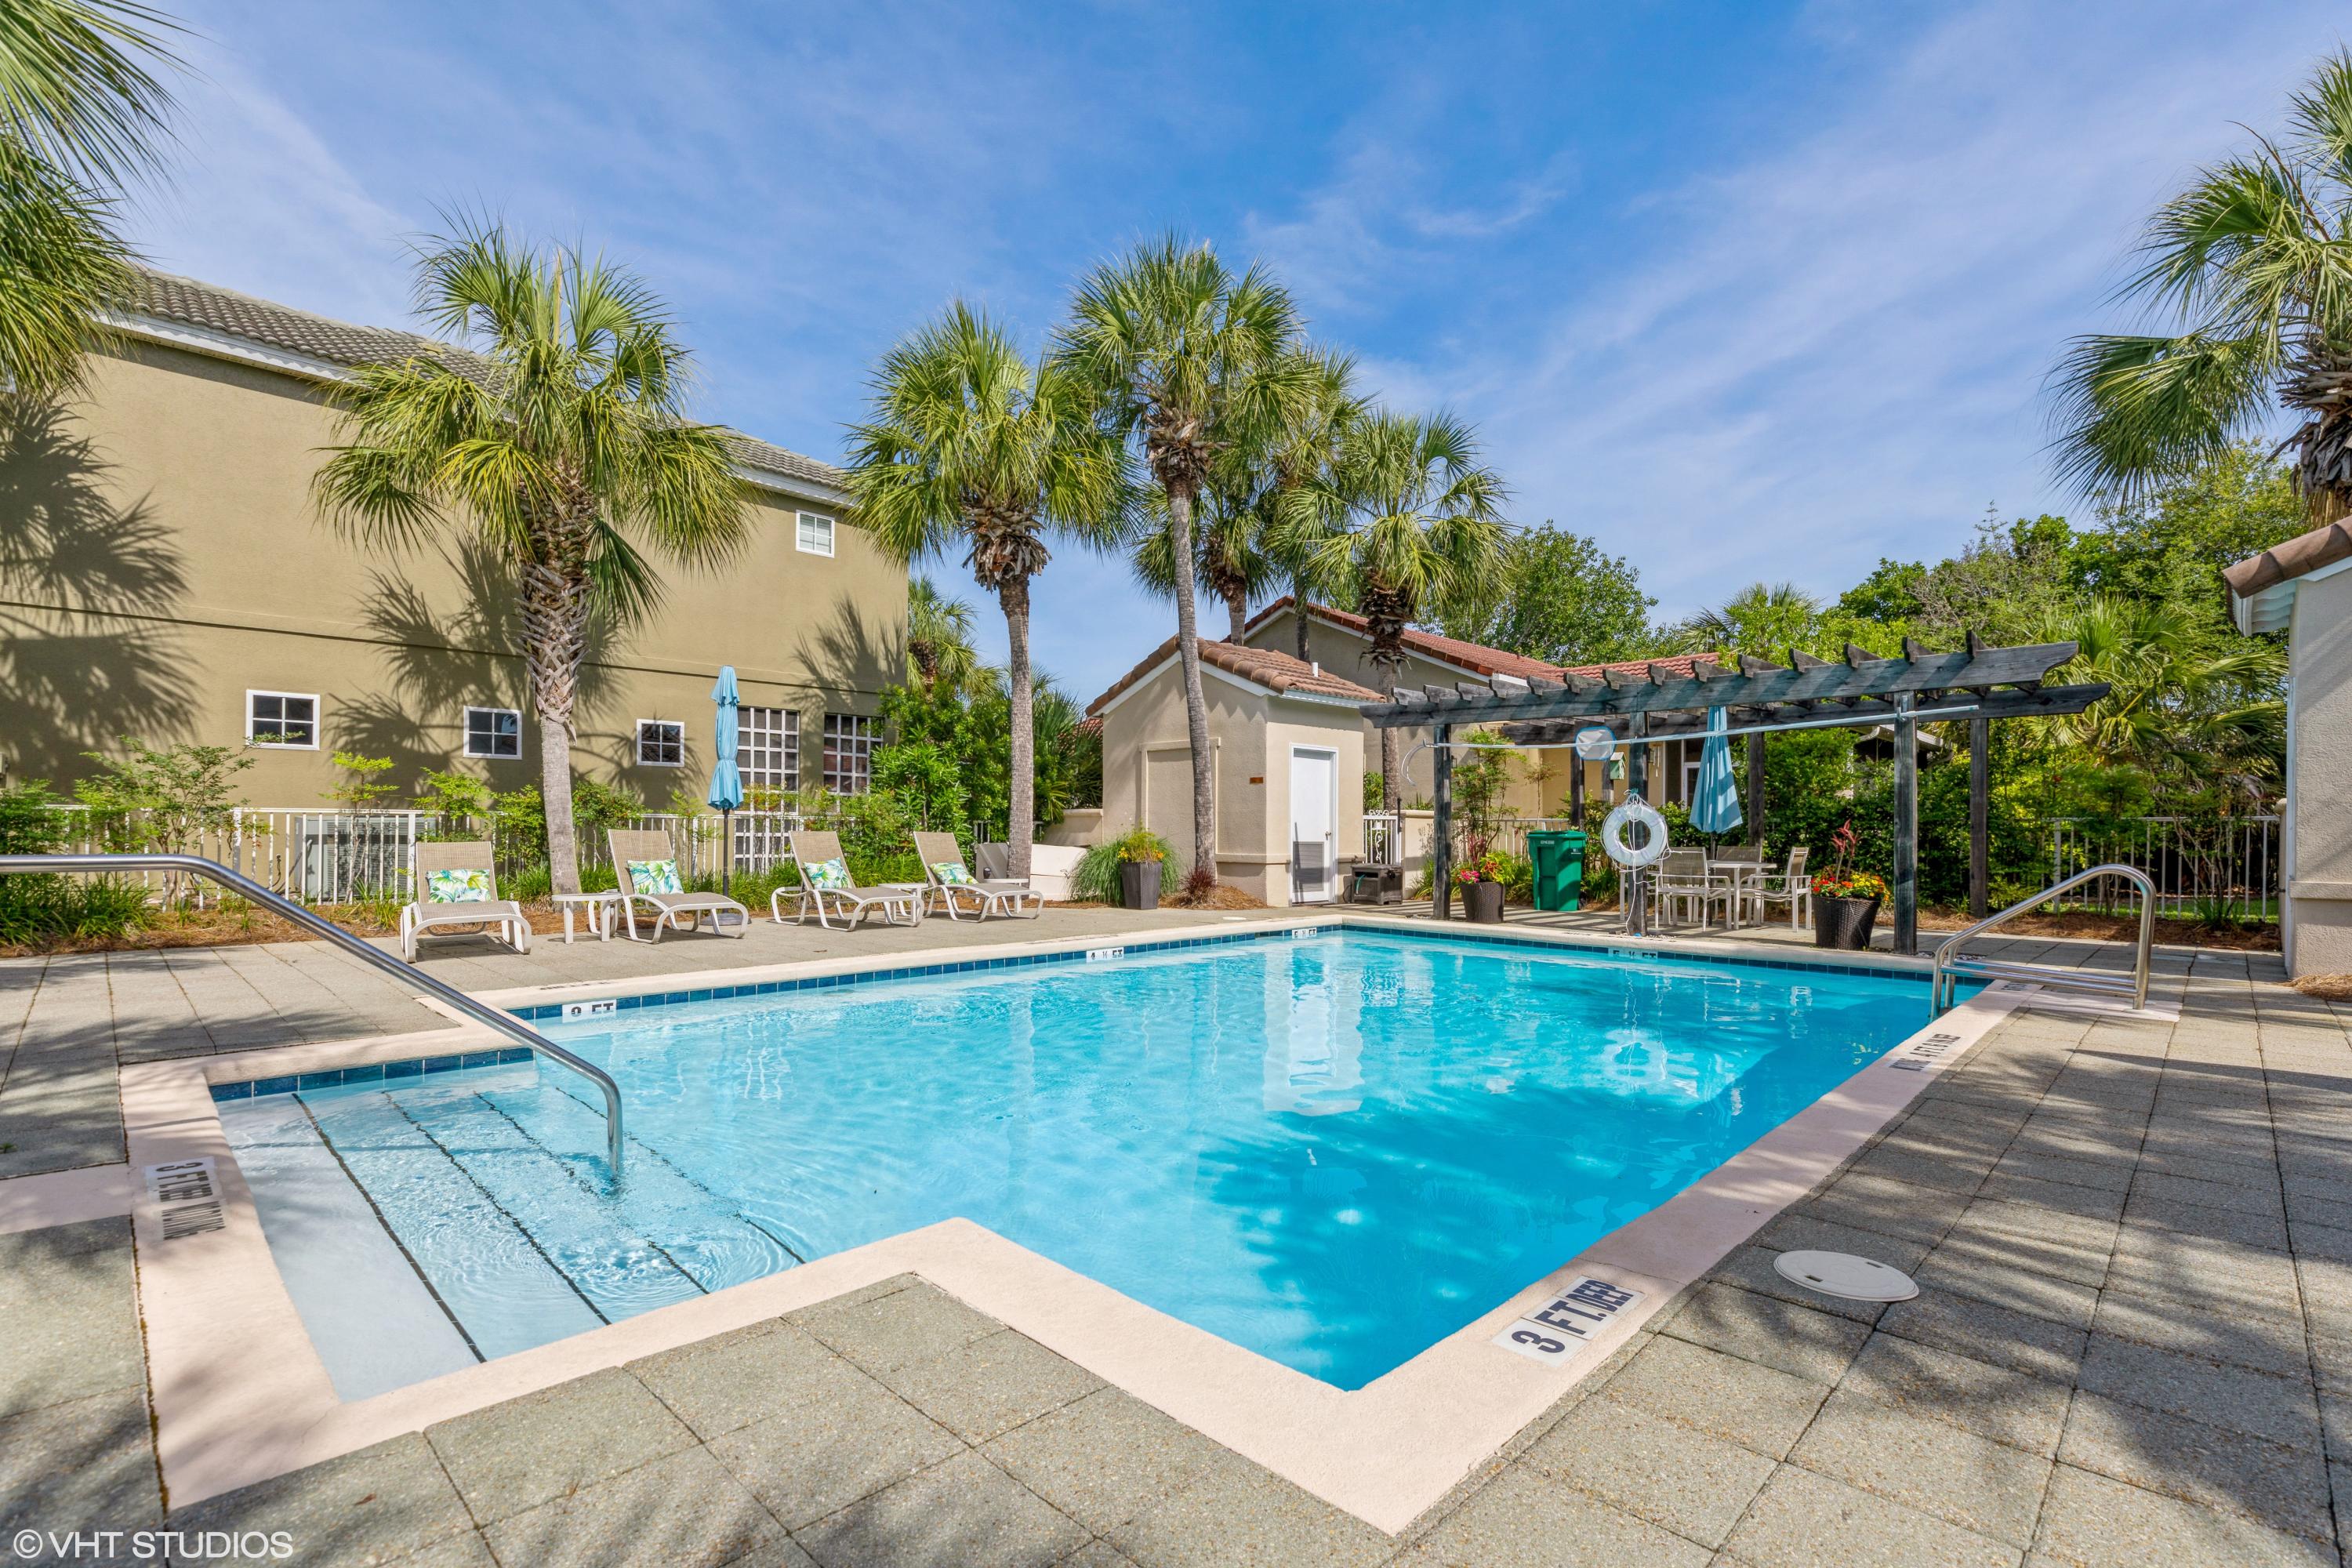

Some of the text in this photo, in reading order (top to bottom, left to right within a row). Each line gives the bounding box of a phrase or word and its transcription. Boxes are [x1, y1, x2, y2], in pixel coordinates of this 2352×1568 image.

[155, 1162, 204, 1172] 3
[1511, 1330, 1566, 1353] 3
[1565, 1279, 1634, 1312] DEEP
